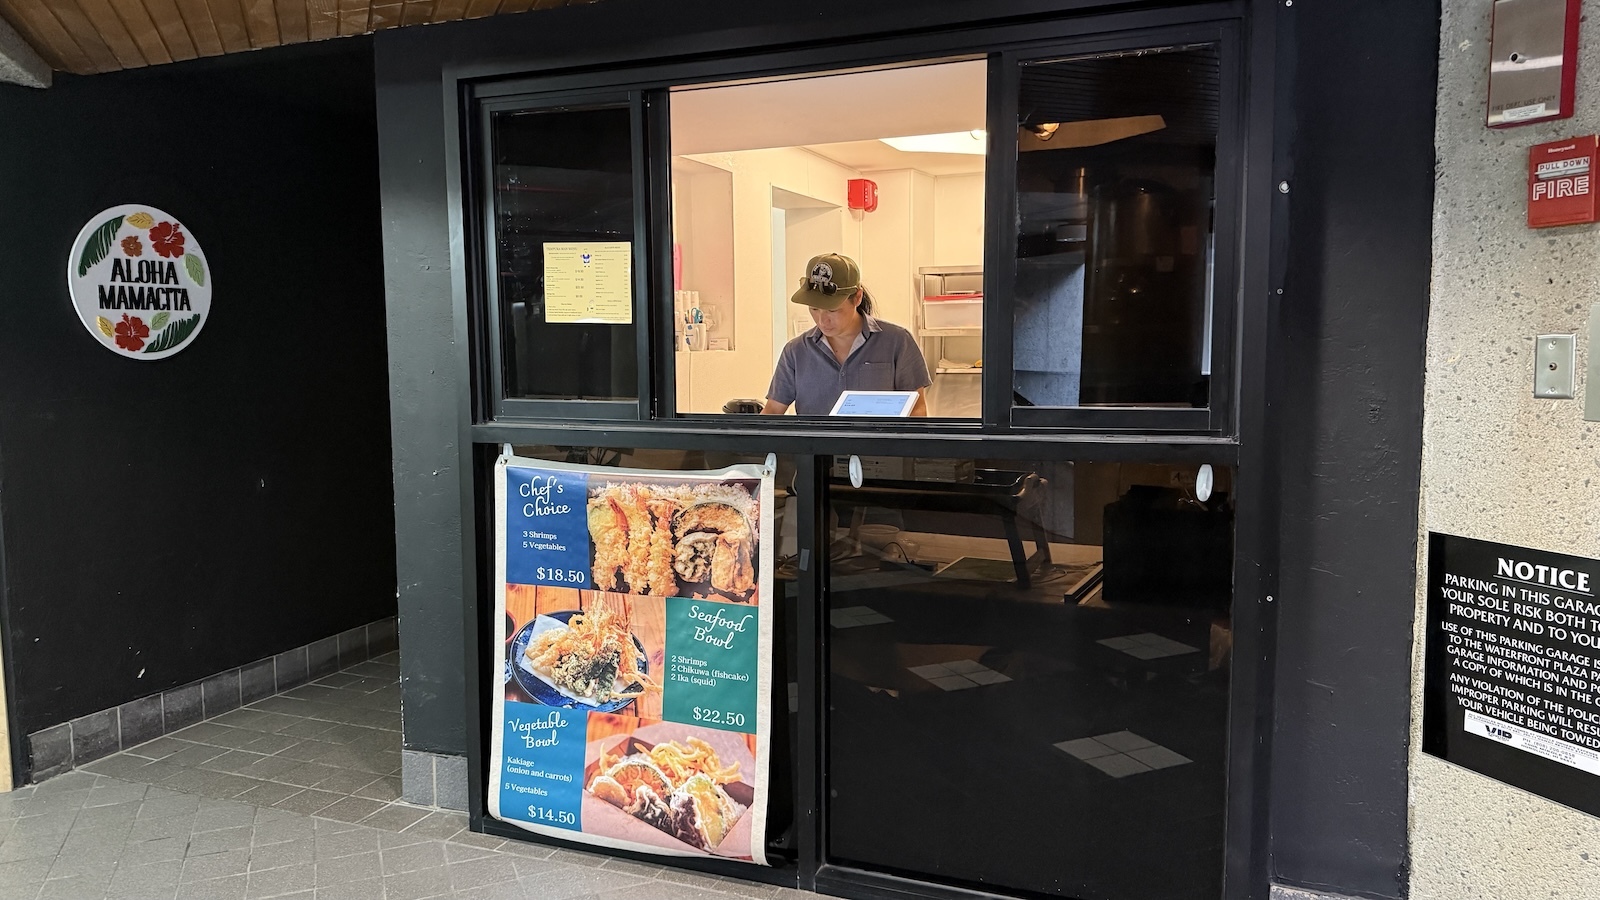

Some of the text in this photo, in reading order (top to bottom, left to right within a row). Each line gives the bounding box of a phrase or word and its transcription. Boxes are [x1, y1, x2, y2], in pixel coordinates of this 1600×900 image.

[1524, 98, 1537, 106] USE
[1539, 157, 1589, 171] PULL DOWN
[1532, 175, 1589, 201] FIRE
[110, 258, 179, 285] ALOHA
[98, 284, 192, 311] MAMACITA
[519, 475, 564, 504] Chef's
[523, 496, 571, 517] Choice
[529, 531, 557, 541] Shrimps
[529, 541, 566, 551] Vegetables
[536, 566, 585, 583] $18.50
[1497, 557, 1591, 592] NOTICE
[1445, 573, 1498, 594] PARKING
[1502, 585, 1516, 598] IN
[1520, 588, 1550, 605] THIS
[688, 605, 753, 632] Seafood
[1441, 586, 1600, 632] YOUR SOLE RISK BOTH T
[1449, 603, 1511, 627] PROPERTY
[1513, 619, 1544, 635] AND
[1548, 625, 1567, 641] TO
[693, 626, 734, 650] Bowl
[1441, 621, 1458, 633] USE
[1460, 626, 1473, 636] OF
[1475, 629, 1497, 642] THIS
[1499, 635, 1544, 654] PARKING
[1546, 647, 1590, 667] GARAGE
[677, 655, 707, 666] Shrimps
[1447, 645, 1485, 663] GARAGE
[1487, 655, 1559, 683] INFORMATION
[1562, 675, 1587, 690] AND
[1449, 634, 1462, 645] TO
[1464, 637, 1482, 650] THE
[1484, 643, 1551, 668] WATERFRONT
[1553, 661, 1588, 679] PLAZA
[670, 673, 717, 687] 2 Ika (squid)
[677, 664, 709, 676] Chikuwa
[711, 669, 749, 682] (fishcake)
[1453, 658, 1460, 667] A
[1462, 660, 1488, 674] COPY
[1489, 668, 1502, 678] OF
[1504, 671, 1540, 690] WHICH
[1544, 683, 1553, 693] IS
[1556, 685, 1567, 697] IN
[1570, 690, 1592, 704] THE
[1450, 672, 1600, 725] ANY VIOLATION OF THE POLIC
[1451, 683, 1499, 705] IMPROPER
[1501, 698, 1545, 720] PARKING
[1547, 712, 1574, 729] WILL
[508, 711, 568, 737] Vegetable
[692, 706, 745, 727] $22.50
[1457, 696, 1483, 712] YOUR
[1484, 704, 1525, 725] VEHICLE
[1527, 715, 1557, 736] BEING
[1560, 728, 1600, 749] TOWED
[521, 729, 559, 748] Bowl
[507, 756, 534, 767] Kakiage
[507, 765, 530, 776] (onion
[545, 772, 572, 783] carrots)
[505, 782, 548, 796] 5 Vegetables
[527, 804, 575, 825] $14.50
